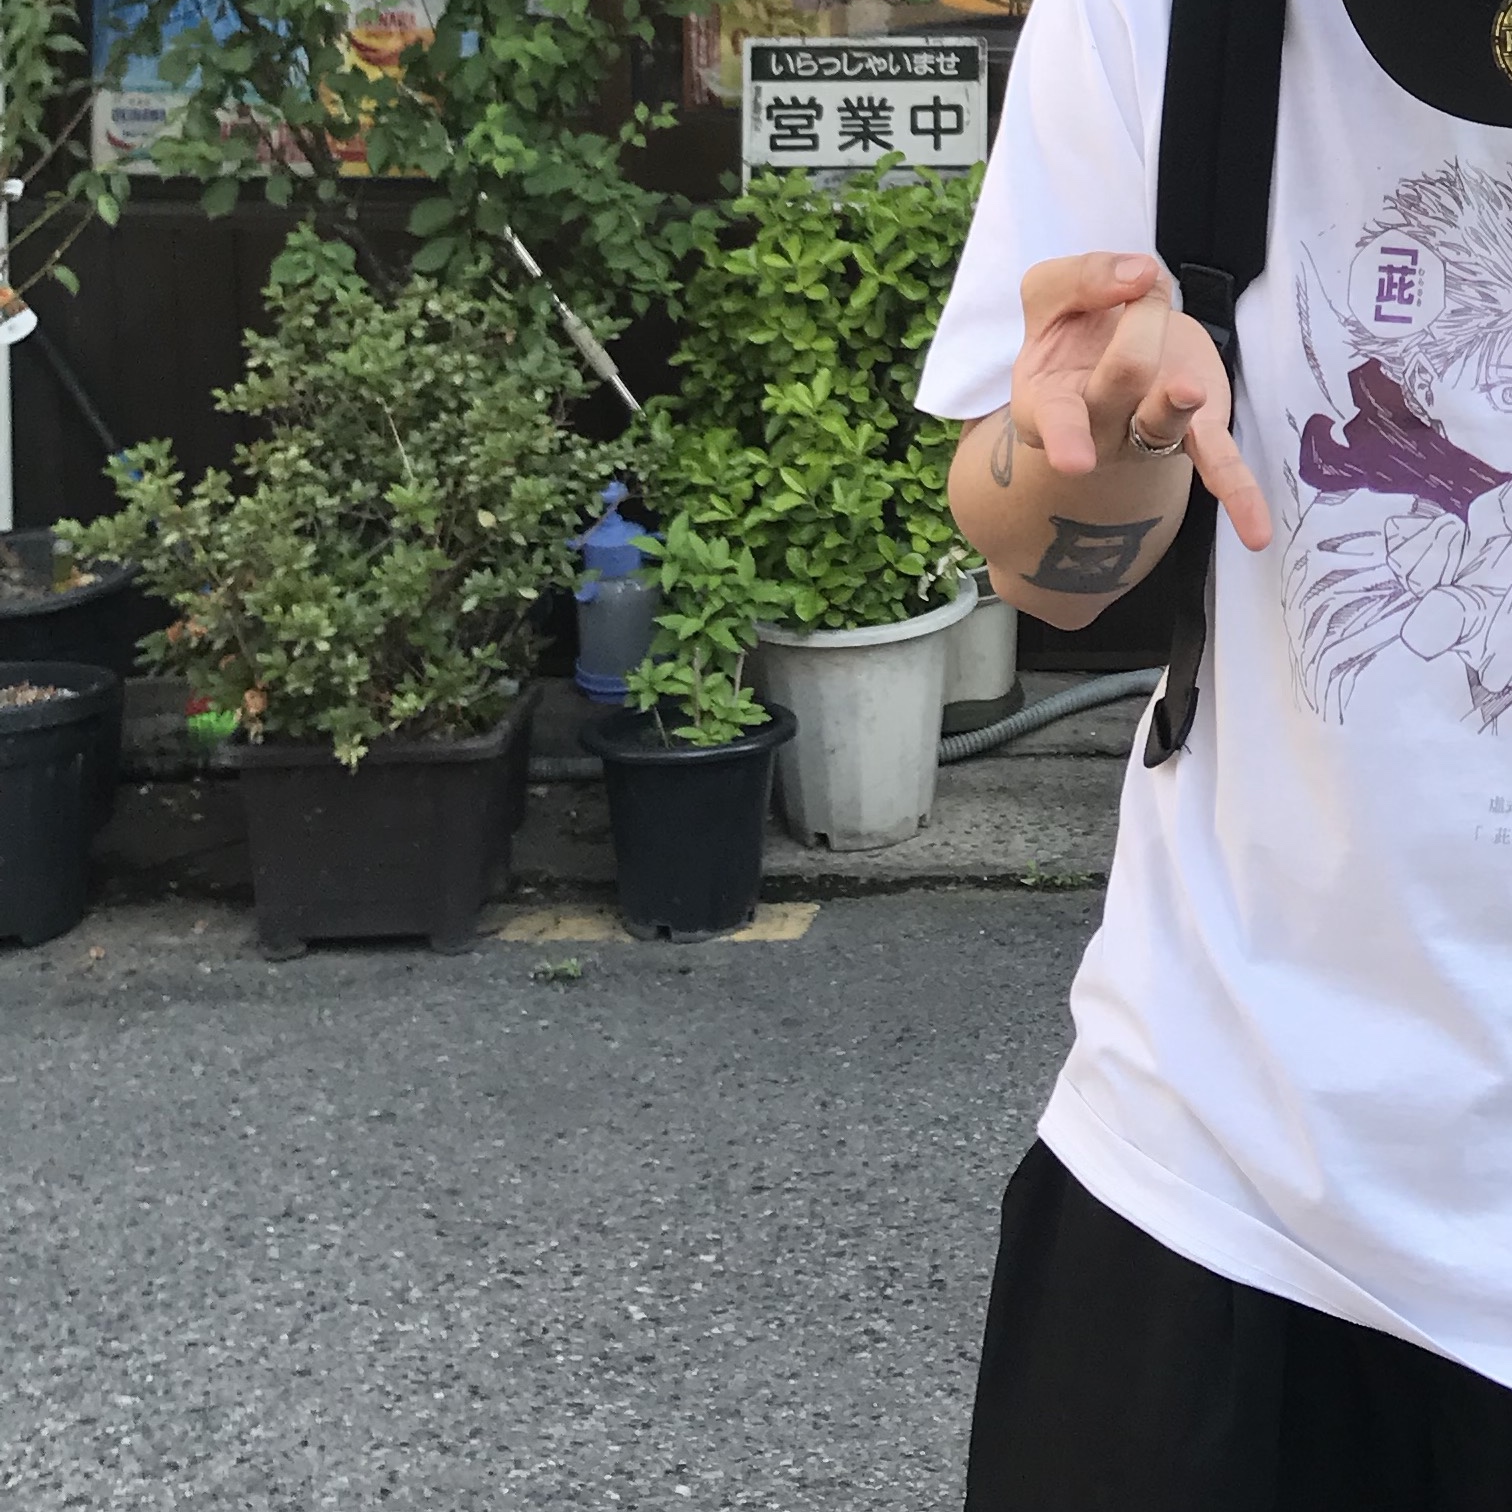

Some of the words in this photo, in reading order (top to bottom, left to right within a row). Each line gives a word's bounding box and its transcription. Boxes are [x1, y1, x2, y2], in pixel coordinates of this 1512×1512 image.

[771, 52, 961, 77] いらっしゃいませ
[766, 95, 965, 152] 営業中
